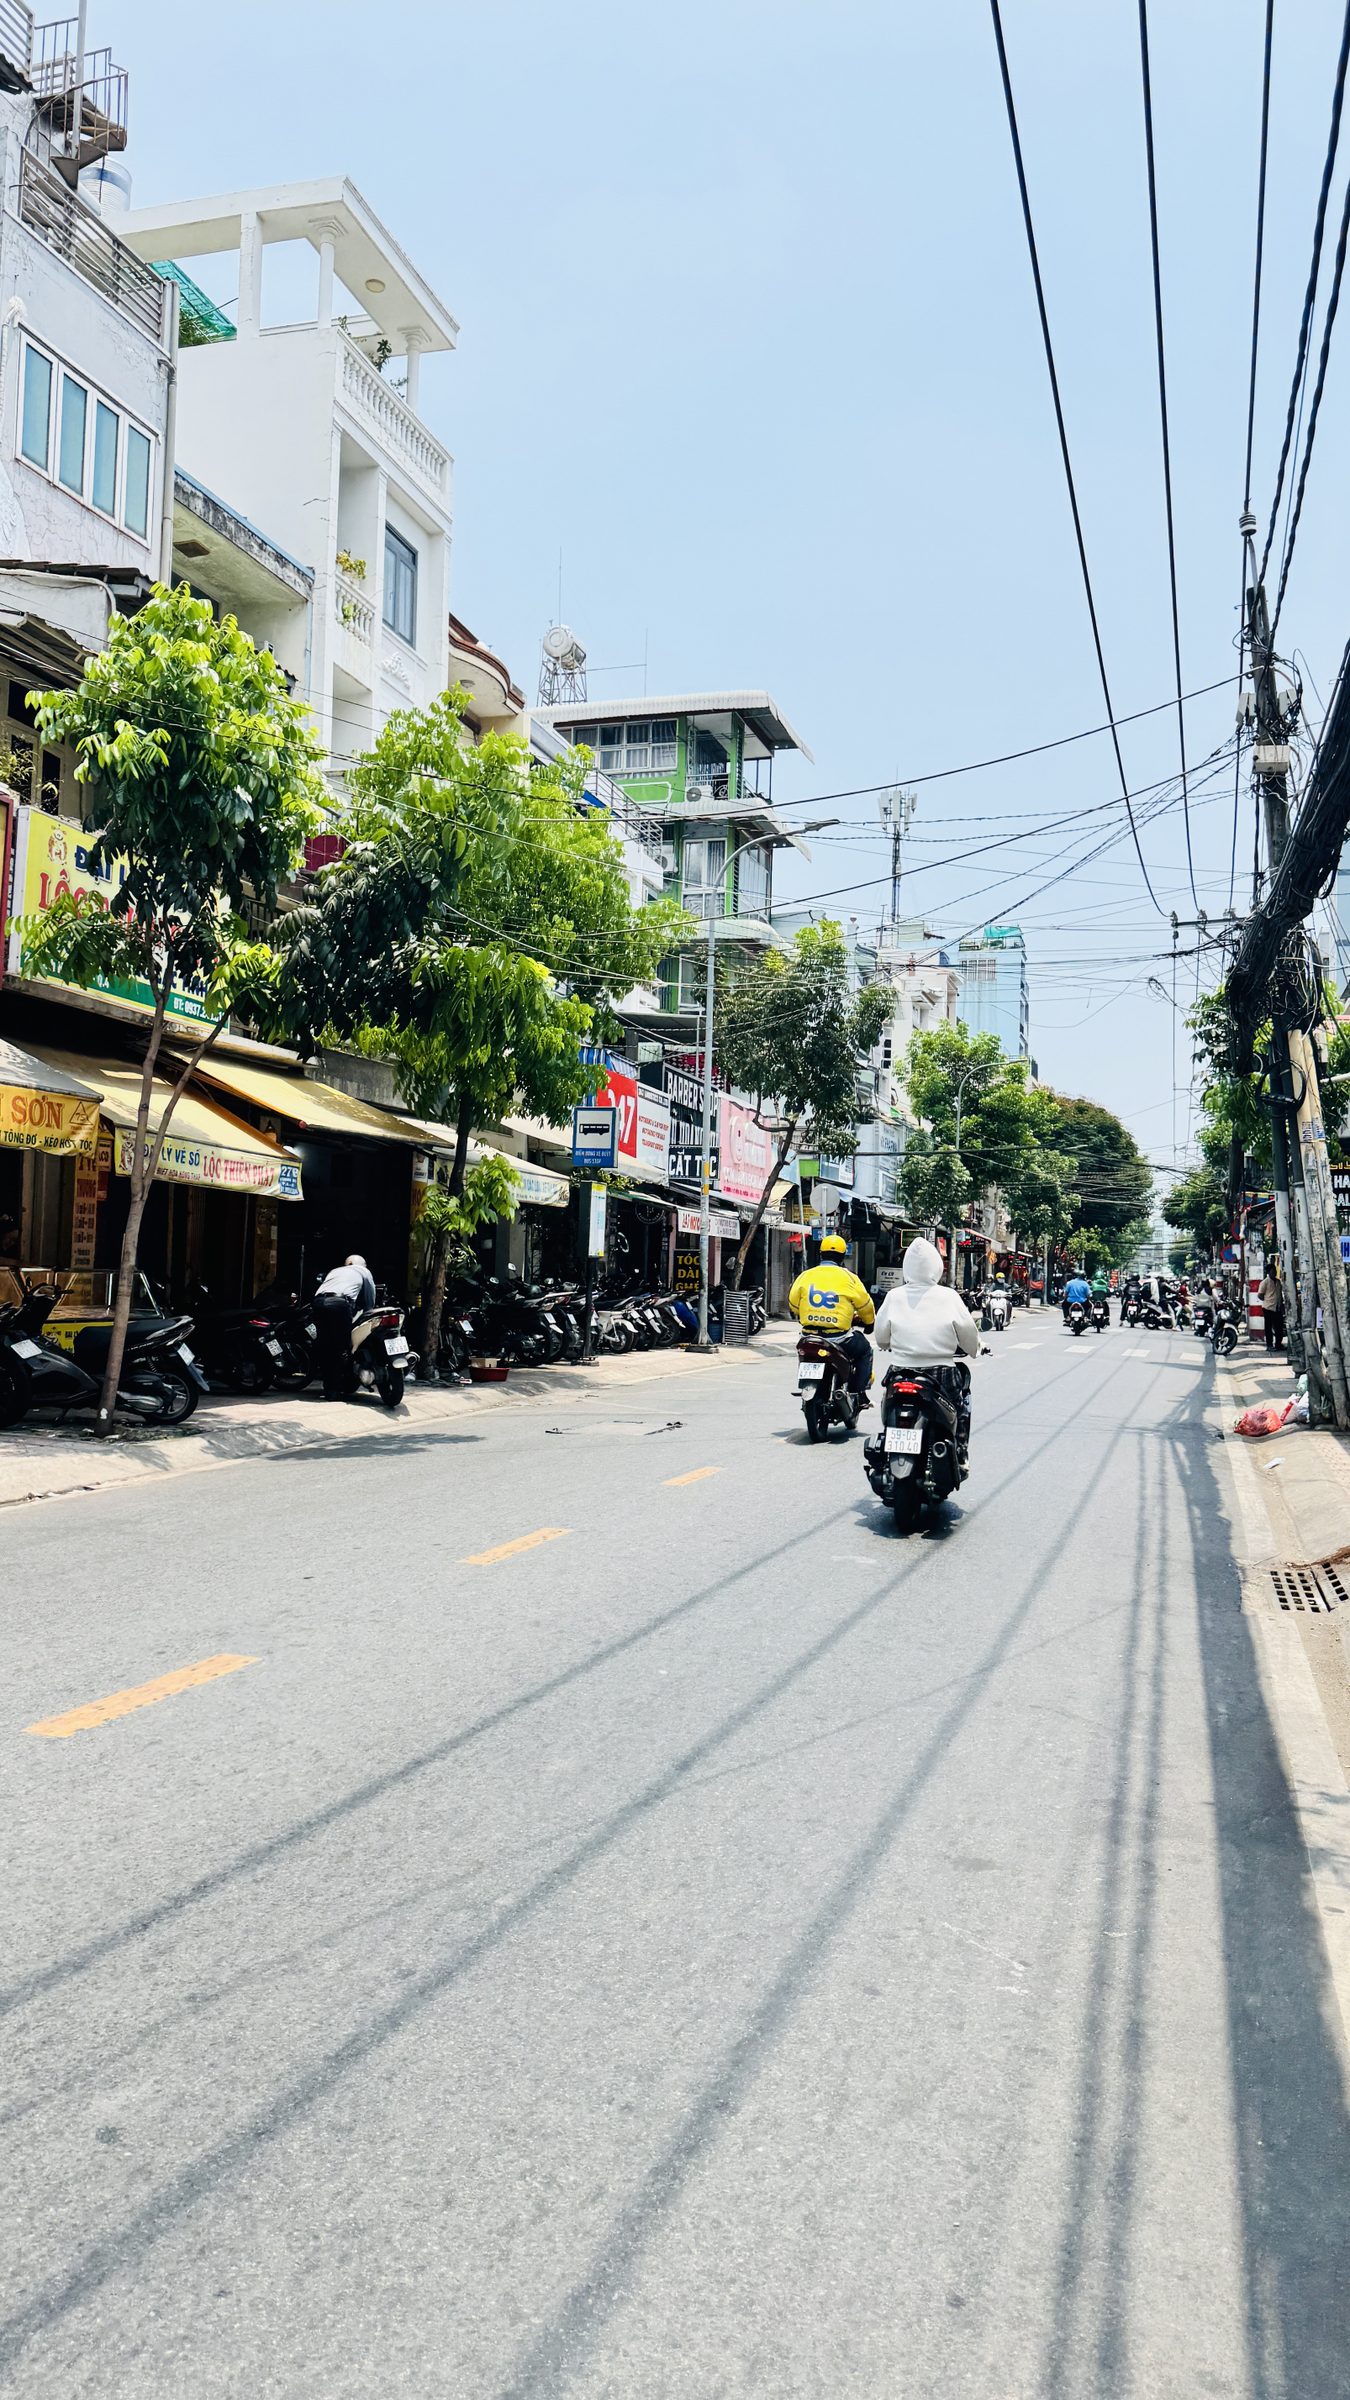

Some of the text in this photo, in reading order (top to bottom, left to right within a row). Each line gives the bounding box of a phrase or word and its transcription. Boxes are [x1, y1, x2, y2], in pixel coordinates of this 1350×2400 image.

[11, 1095, 63, 1129] SƠN
[80, 1137, 93, 1151] TÓC
[161, 1144, 173, 1161] LÝ
[203, 1151, 222, 1183] LỘC
[669, 1149, 717, 1177] CẮT TC
[677, 1253, 700, 1265] TÓC
[678, 1266, 700, 1278] DÀI
[808, 1283, 840, 1309] be
